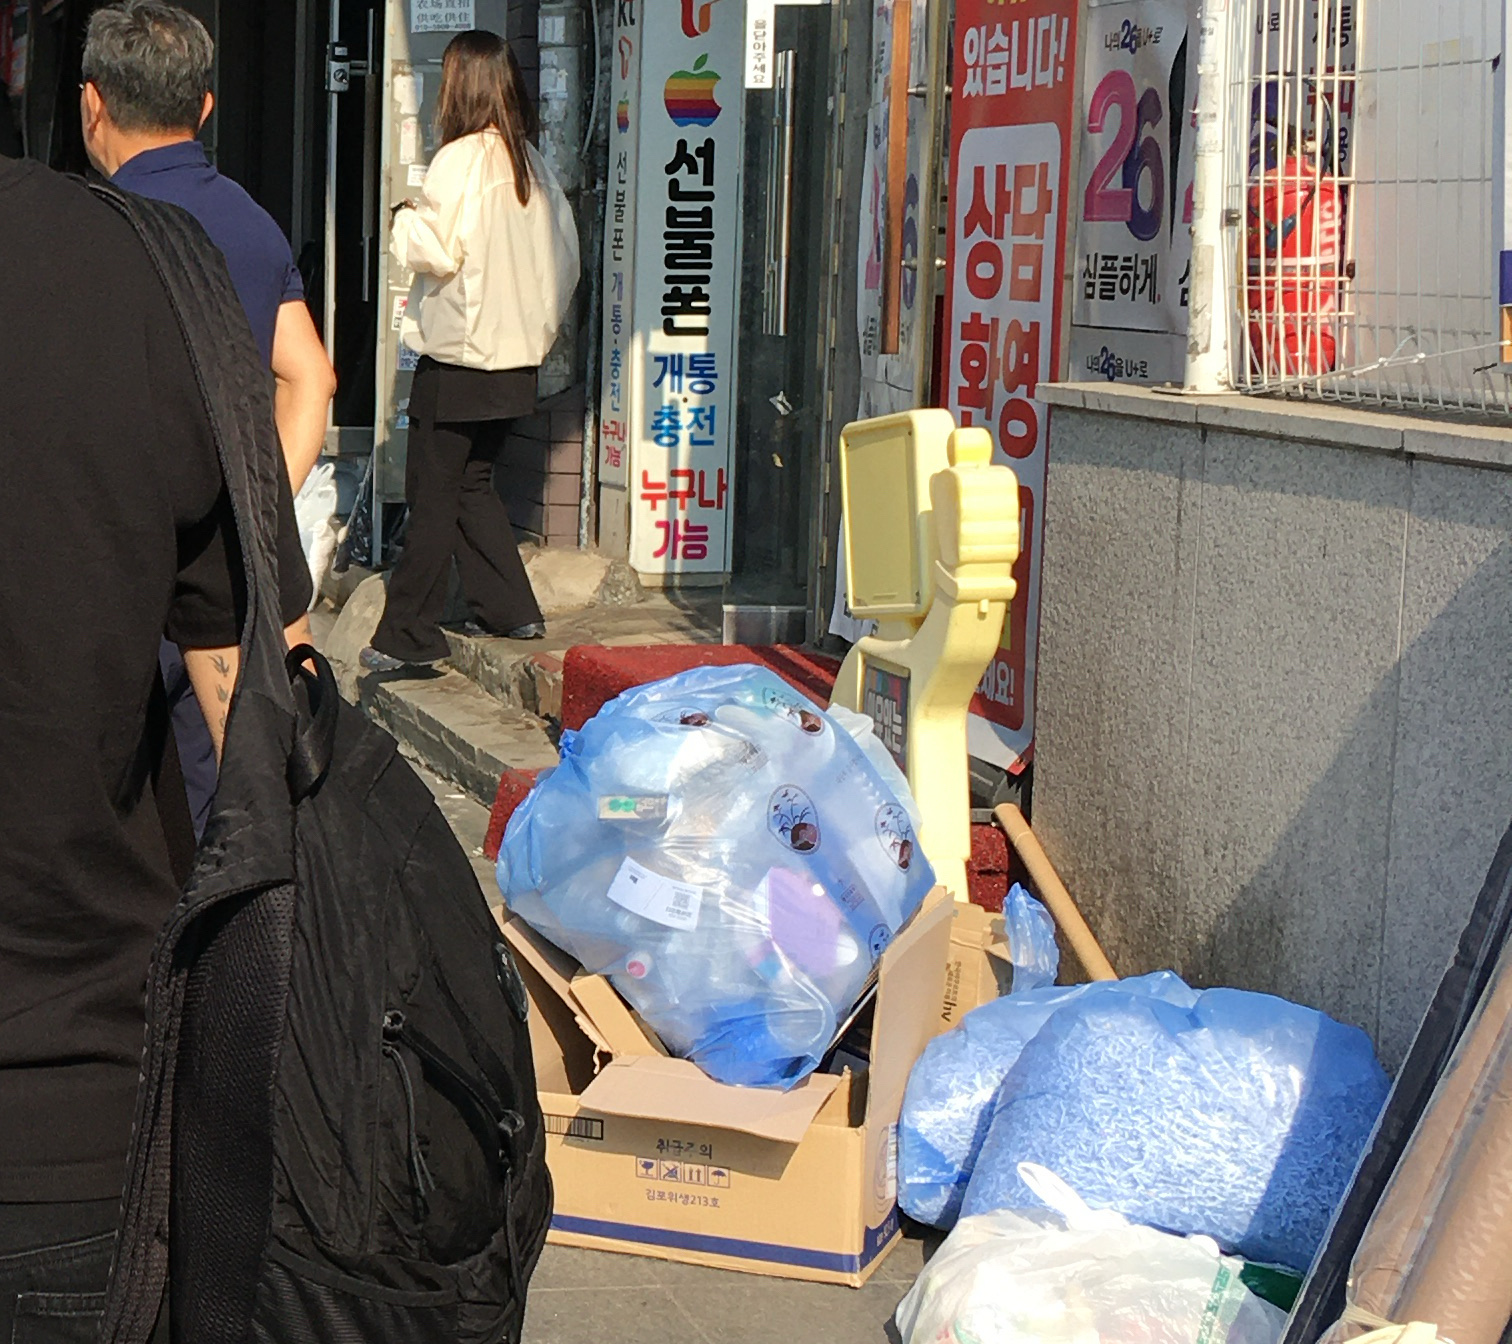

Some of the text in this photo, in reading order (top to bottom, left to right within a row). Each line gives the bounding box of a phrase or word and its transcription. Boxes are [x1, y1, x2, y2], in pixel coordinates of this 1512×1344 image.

[962, 13, 1070, 100] 있습니다!
[1104, 28, 1120, 52] 나의
[1083, 69, 1165, 242] 26
[612, 150, 628, 262] 선불폰
[660, 137, 715, 337] 선불폰
[962, 160, 1053, 304] 상담
[1083, 252, 1162, 306] 심플하게.
[653, 351, 719, 396] 개통
[958, 310, 1040, 460] 환영
[1125, 358, 1149, 380] U+로
[650, 404, 716, 448] 충전
[640, 467, 728, 511] 누구나
[652, 518, 709, 561] 가능
[644, 1187, 721, 1210] 김포위생213호
